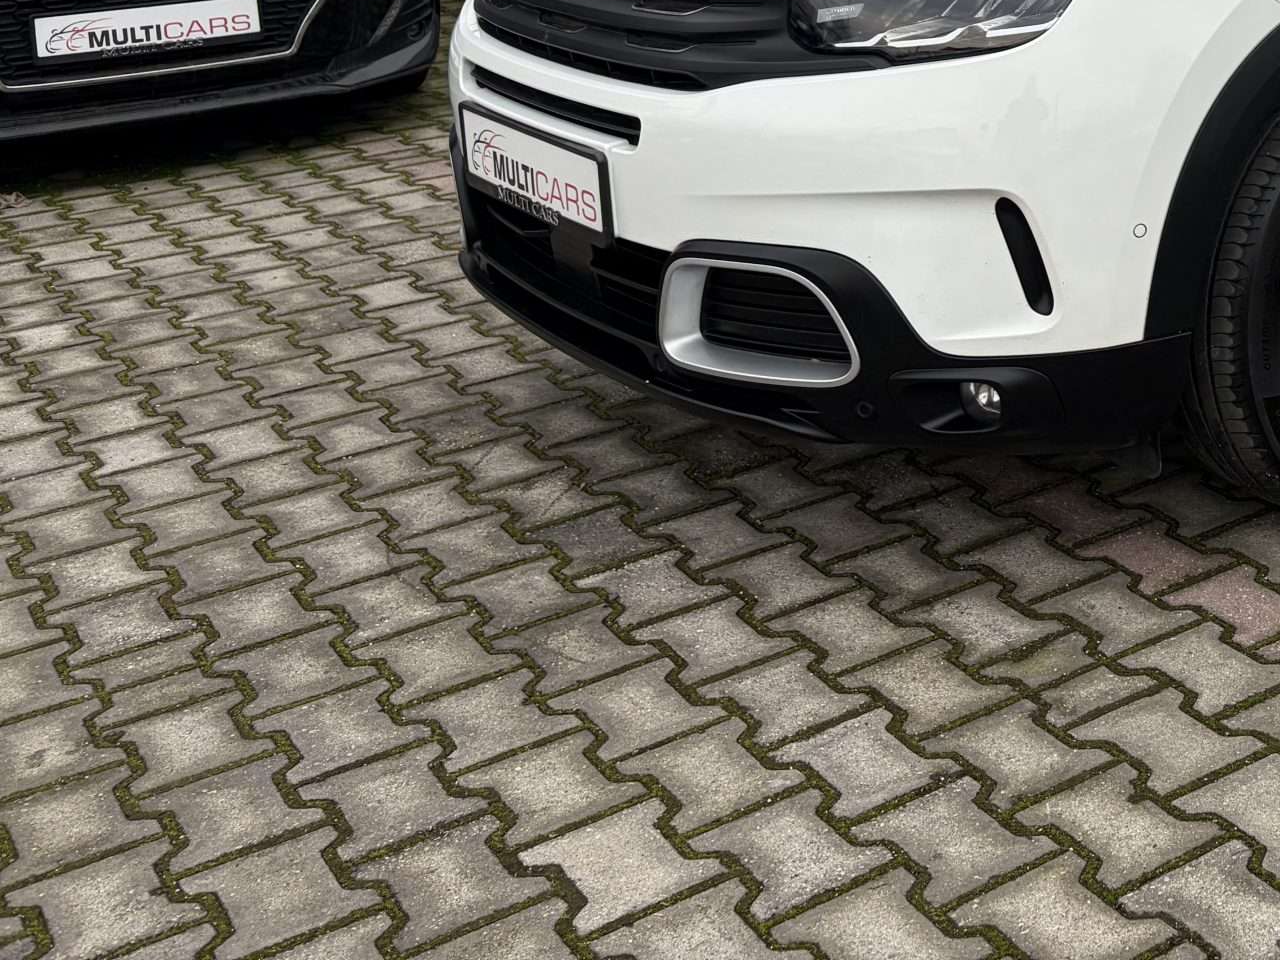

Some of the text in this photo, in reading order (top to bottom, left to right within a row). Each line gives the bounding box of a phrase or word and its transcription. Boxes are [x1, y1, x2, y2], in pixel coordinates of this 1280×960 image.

[88, 14, 251, 49] MULTICARS
[491, 151, 597, 223] MULTICARS
[497, 184, 560, 226] MULTI CARS
